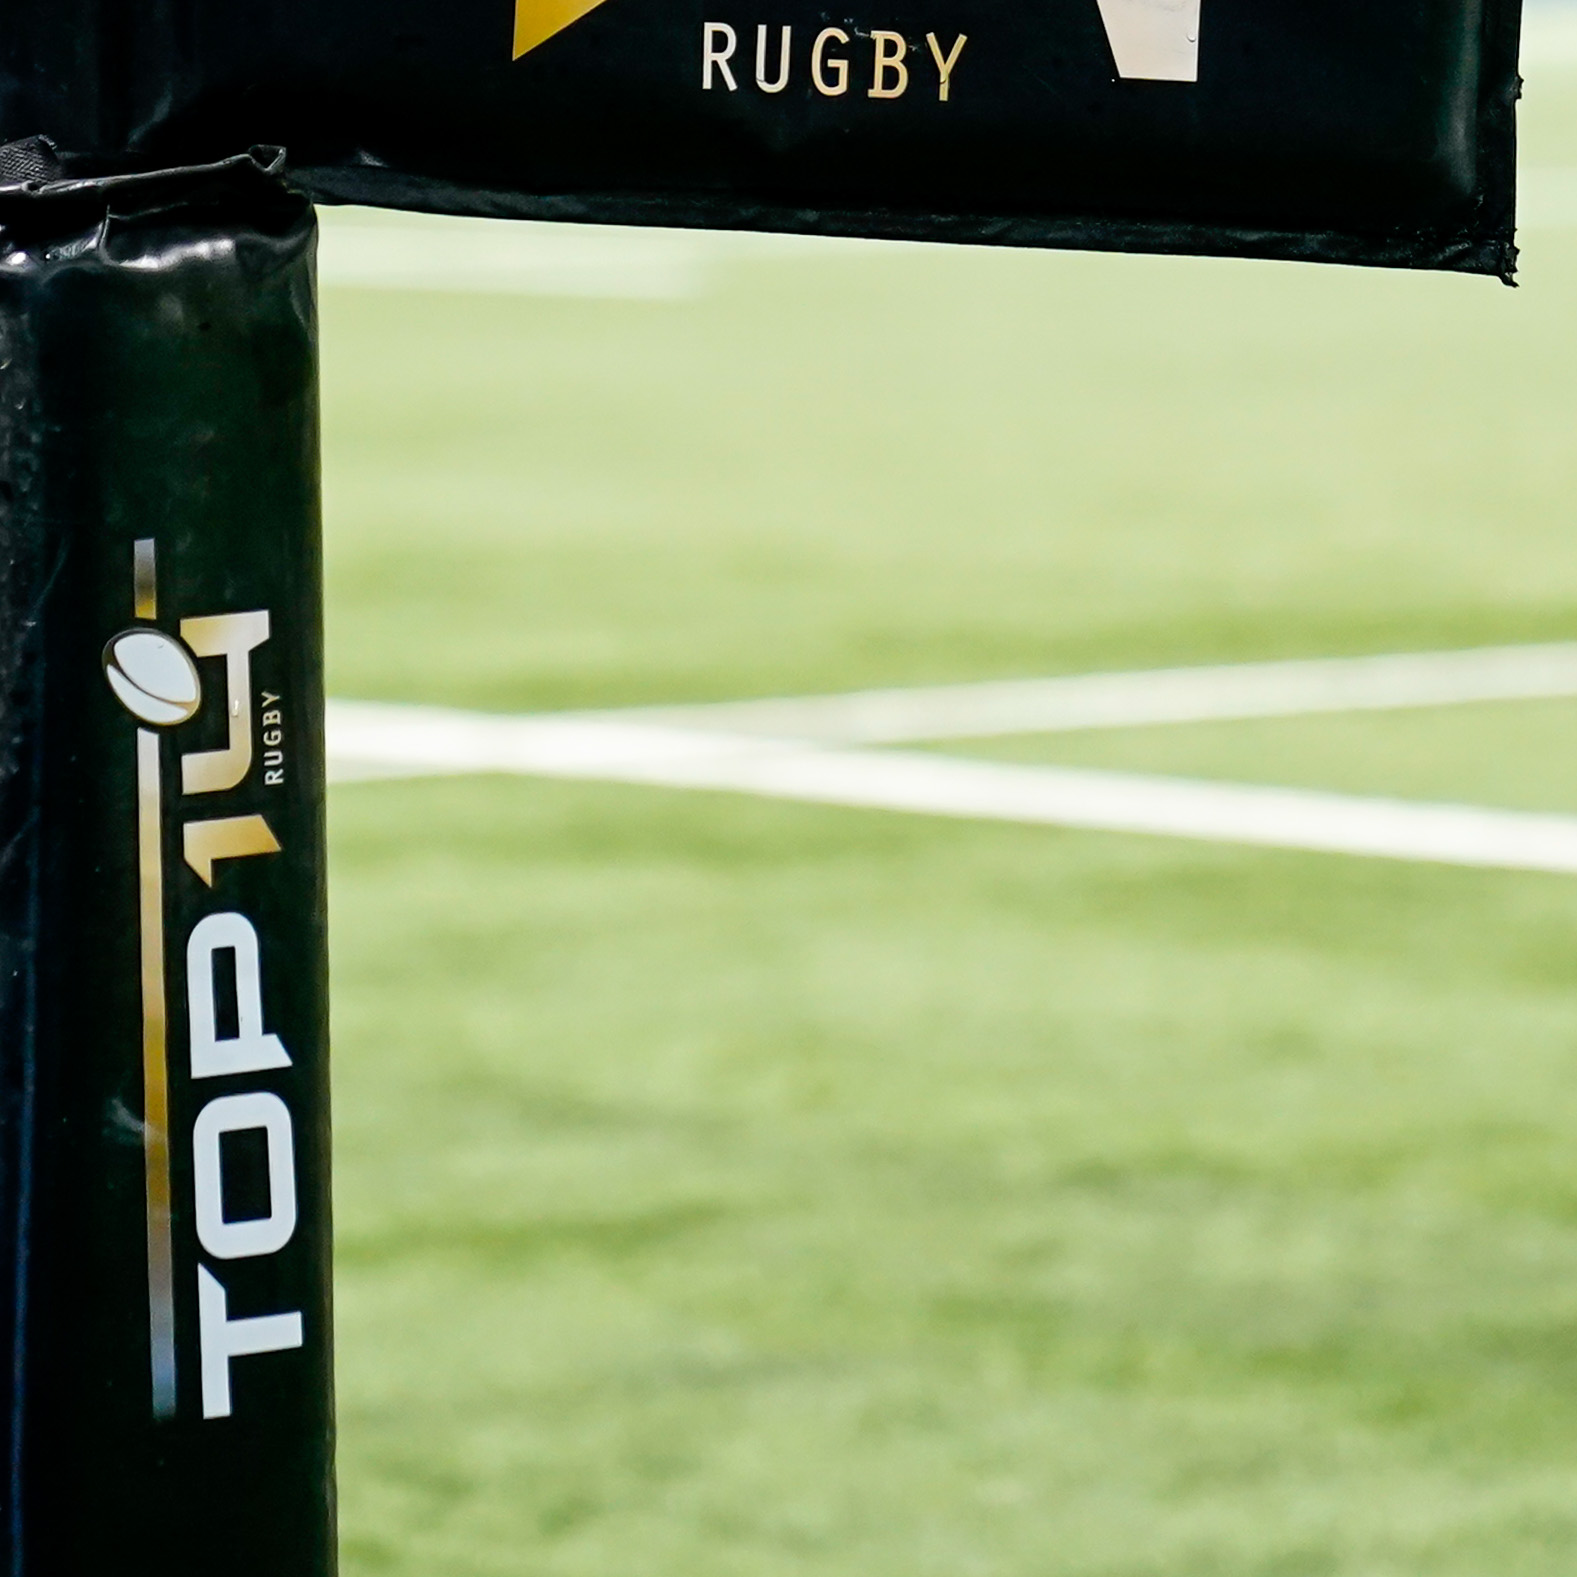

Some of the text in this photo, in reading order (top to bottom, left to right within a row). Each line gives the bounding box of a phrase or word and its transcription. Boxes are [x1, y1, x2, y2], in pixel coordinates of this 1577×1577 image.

[703, 22, 968, 101] RUGBY
[263, 690, 284, 785] RUGBY
[180, 611, 304, 1419] TOP 14
